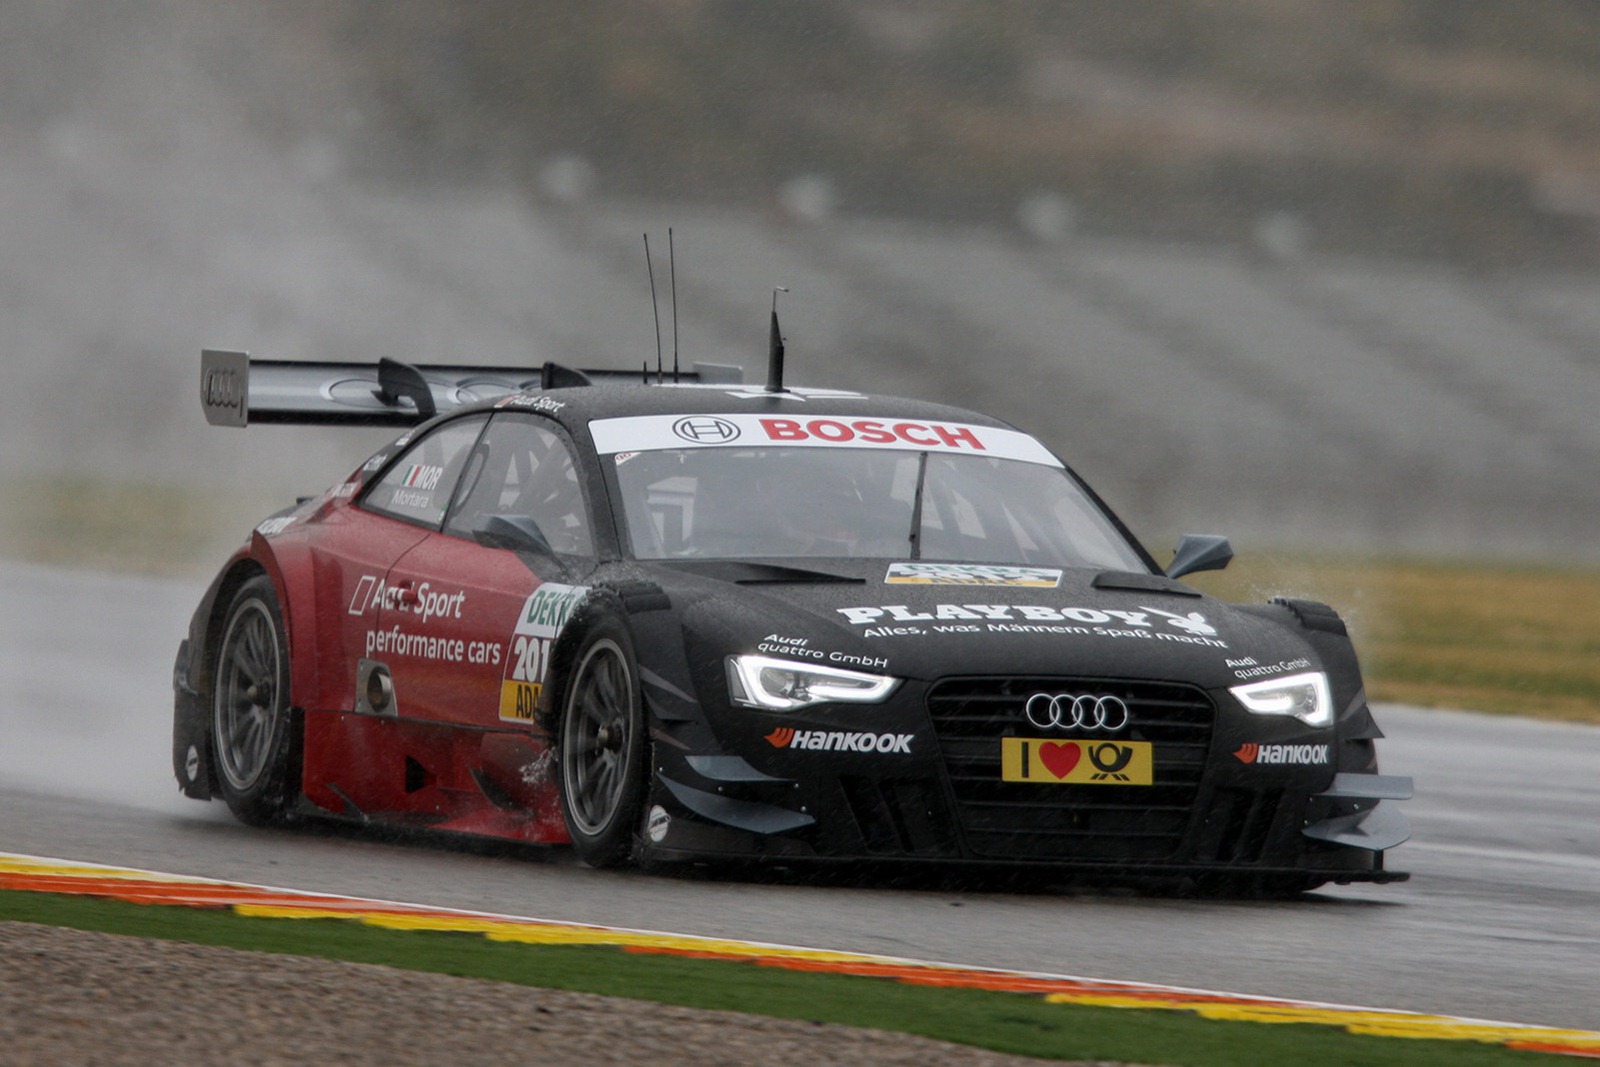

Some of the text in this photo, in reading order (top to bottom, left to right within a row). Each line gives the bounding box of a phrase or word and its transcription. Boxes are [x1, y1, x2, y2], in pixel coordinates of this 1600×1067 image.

[759, 418, 987, 451] BOSCH
[414, 465, 443, 490] MOR
[391, 489, 429, 508] Mortara
[413, 582, 465, 624] Sport
[526, 589, 589, 627] DEKR
[836, 603, 1152, 628] PLAYBOY
[365, 624, 501, 665] performance cars
[763, 633, 808, 646] Audi
[863, 623, 1229, 648] Alles, was Männern Spaß macht
[757, 641, 888, 668] quattro GmbH
[1225, 656, 1257, 668] Audi
[1234, 657, 1312, 680] quattro GmbH
[1021, 741, 1029, 778] I
